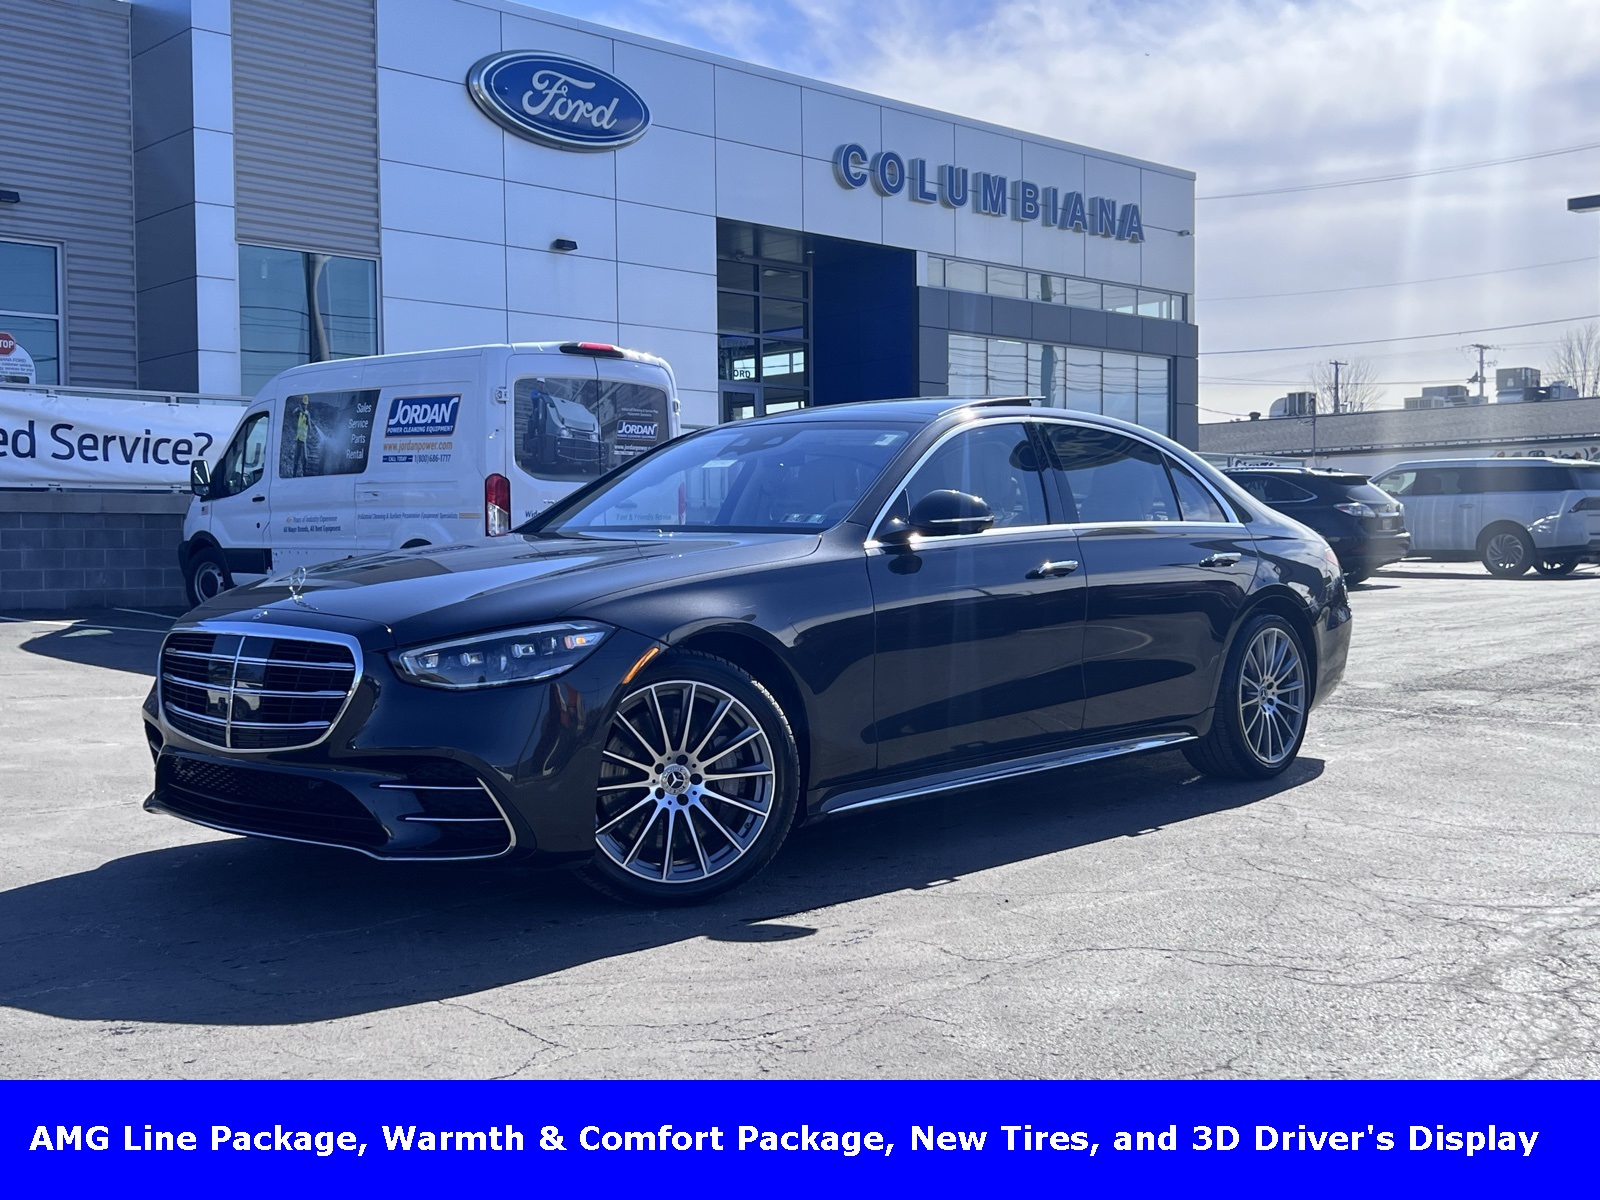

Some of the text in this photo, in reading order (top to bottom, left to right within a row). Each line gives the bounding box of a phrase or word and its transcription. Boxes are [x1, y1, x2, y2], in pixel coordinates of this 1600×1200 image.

[522, 70, 620, 130] Ford
[834, 142, 1146, 243] COLUMBIANA
[357, 402, 372, 414] Sales
[389, 397, 459, 426] JORDAN
[349, 418, 369, 429] Service
[426, 425, 454, 433] EQUIPMENT
[618, 421, 658, 435] JORDAN
[50, 423, 214, 466] Service?
[351, 434, 366, 444] Parts
[383, 440, 453, 453] www.jordanpower.com
[346, 449, 364, 460] Rental
